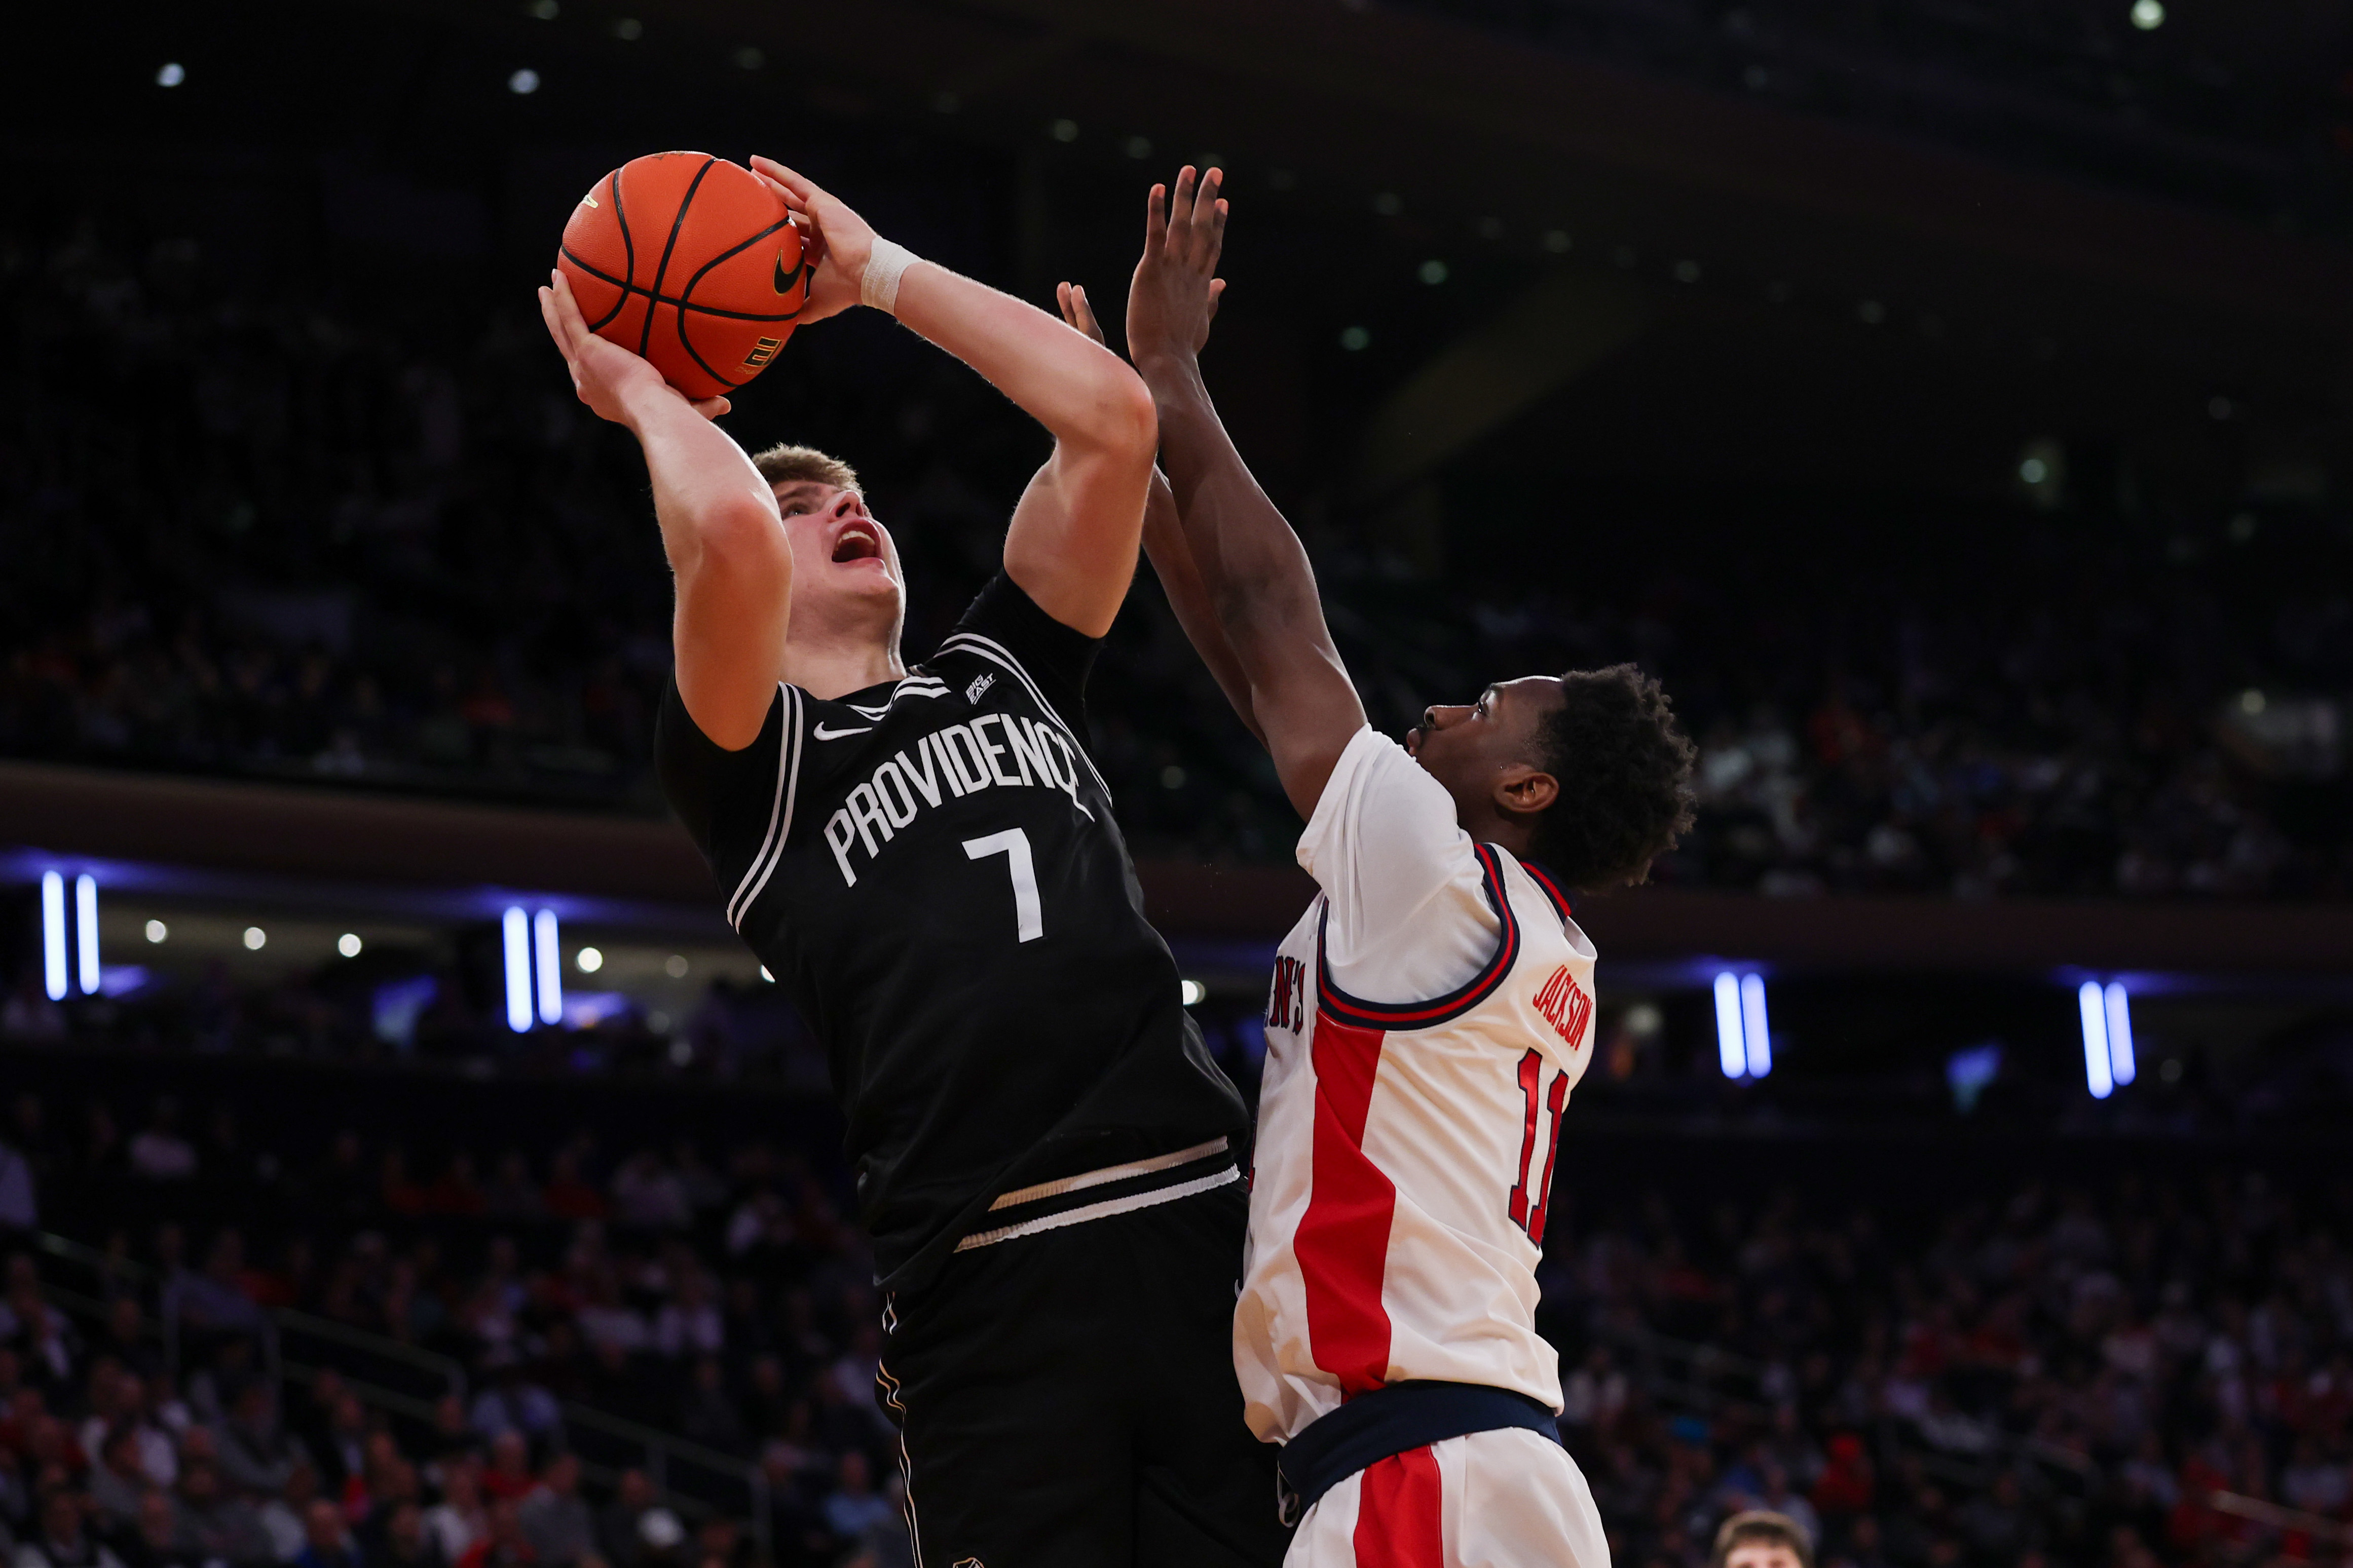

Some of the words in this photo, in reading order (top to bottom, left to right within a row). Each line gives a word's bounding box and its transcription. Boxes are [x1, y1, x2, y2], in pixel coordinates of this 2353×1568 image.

[965, 674, 984, 698] BIG
[968, 672, 993, 705] EAST
[962, 827, 1043, 943] 7
[1533, 965, 1593, 1051] JACKSON
[1508, 1047, 1569, 1250] 11
